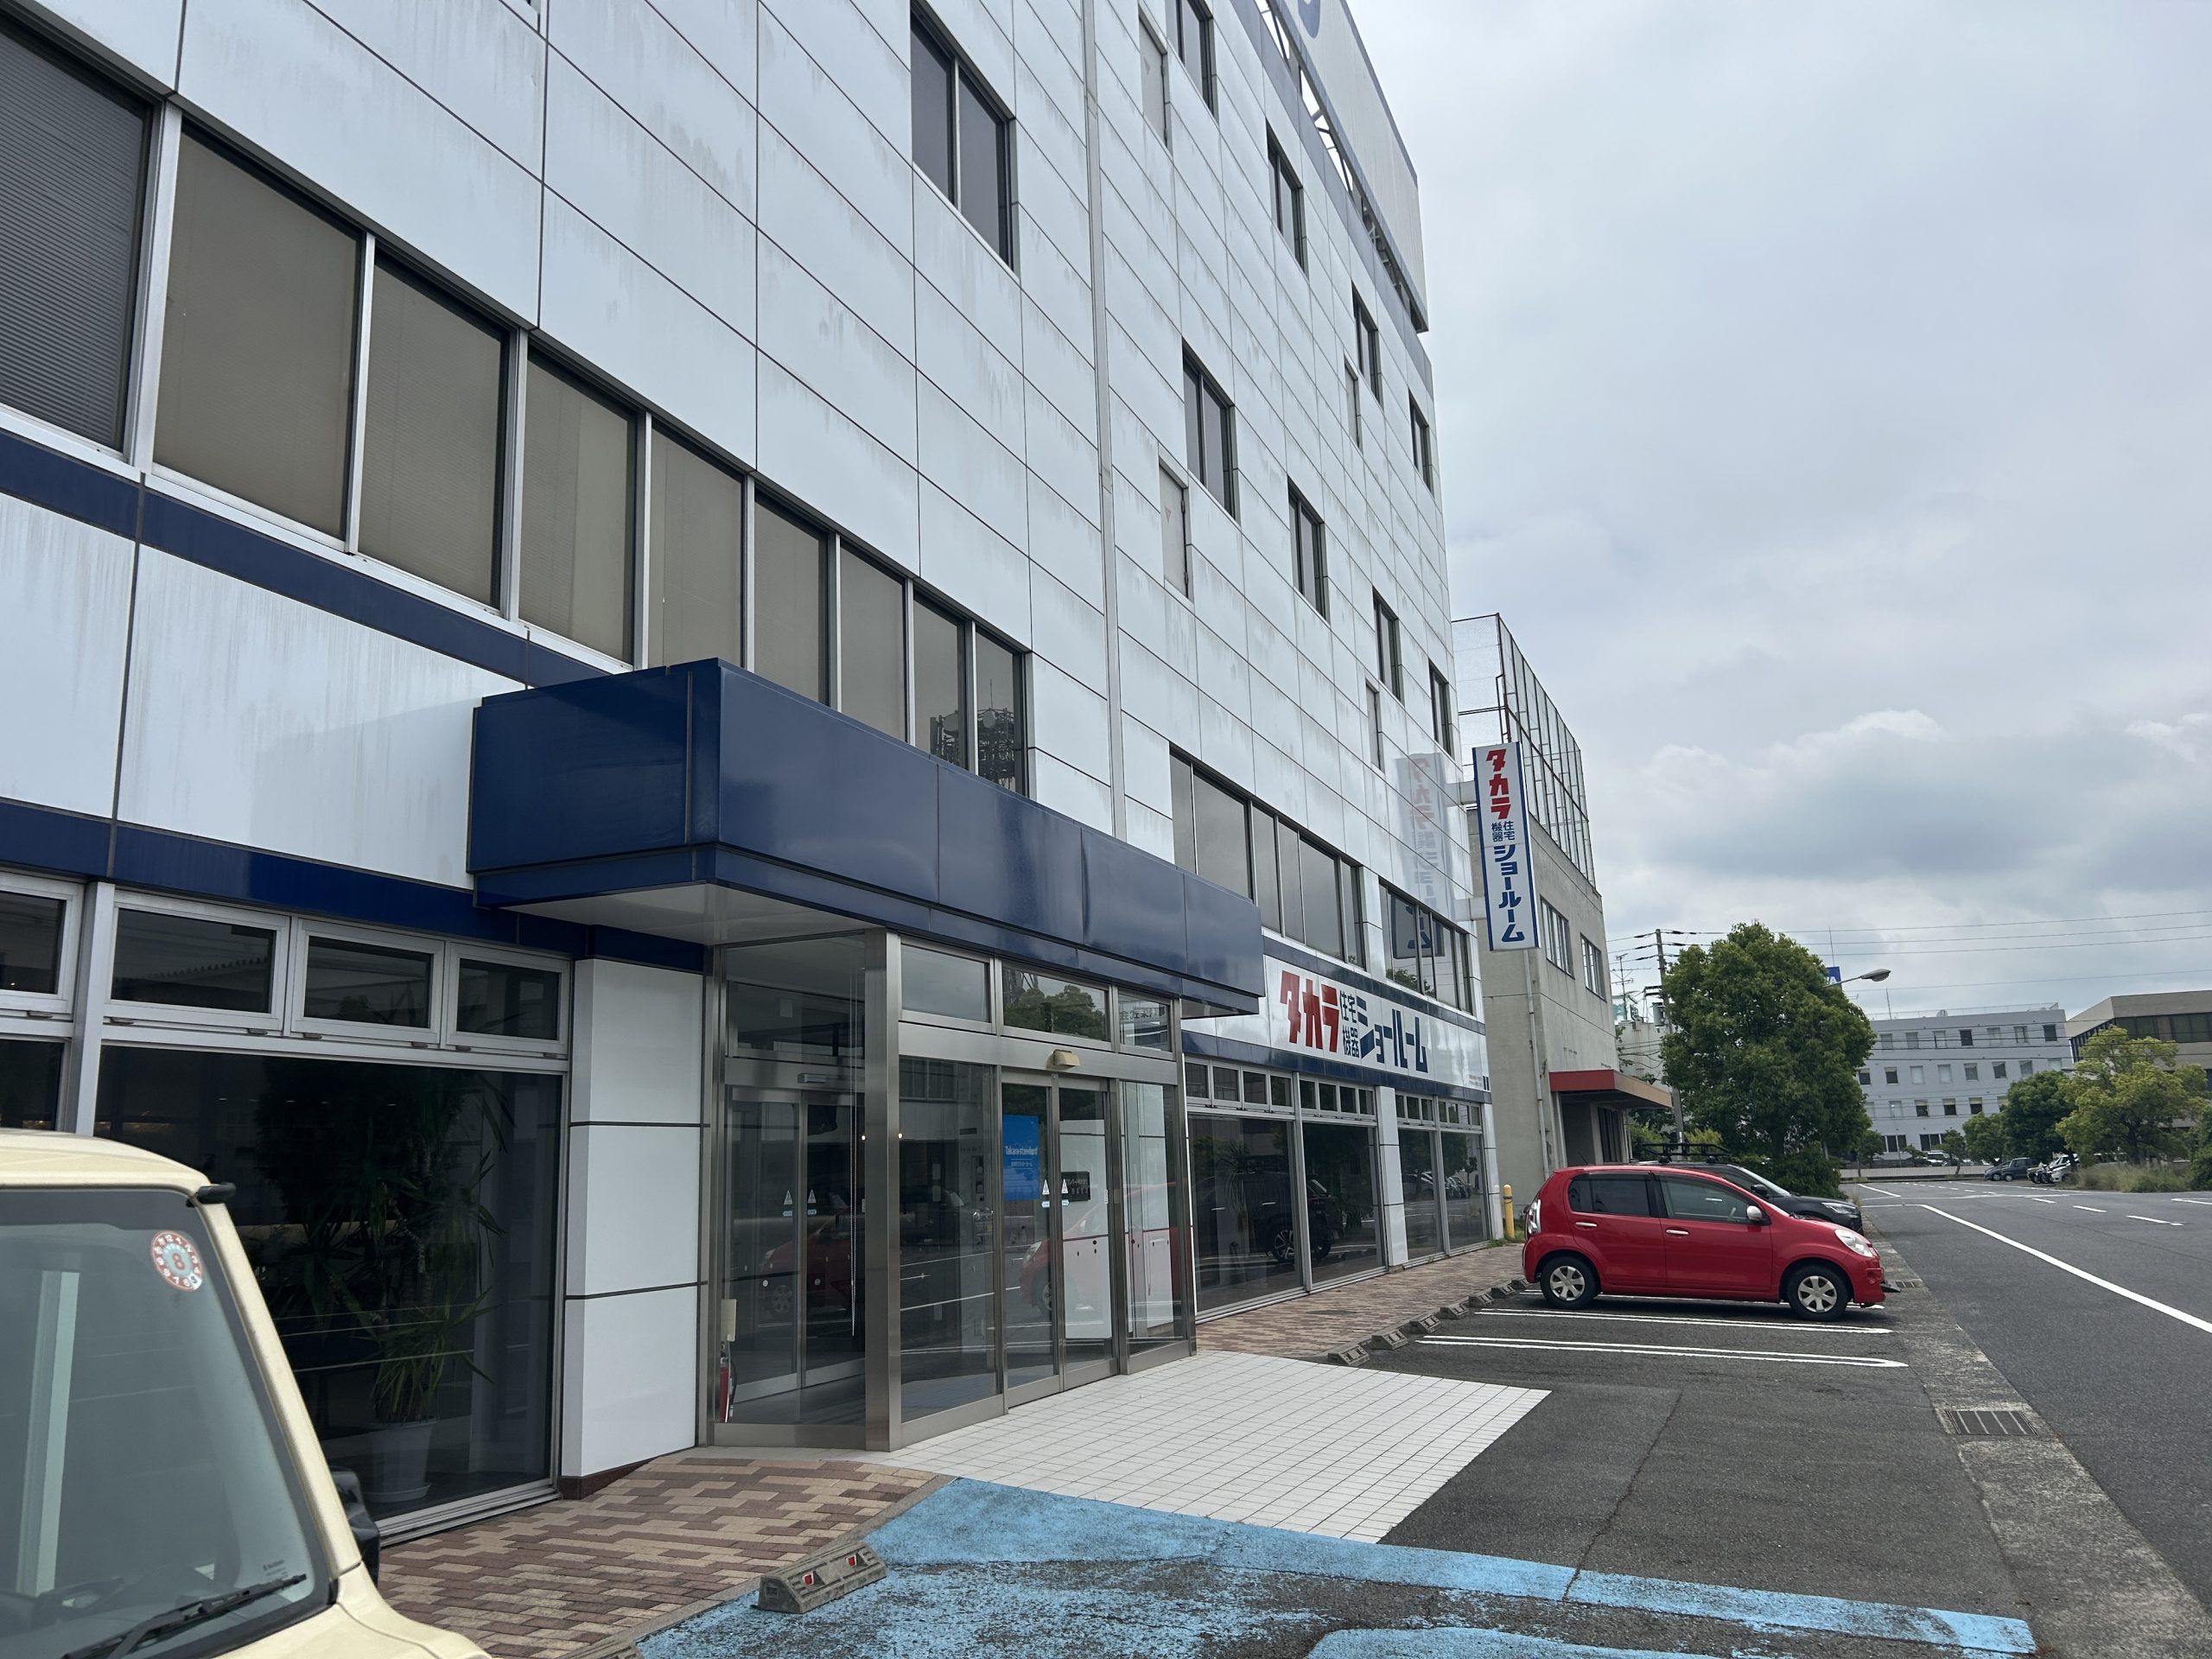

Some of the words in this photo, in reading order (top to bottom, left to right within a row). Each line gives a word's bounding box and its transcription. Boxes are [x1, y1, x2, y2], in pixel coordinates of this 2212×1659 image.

[1486, 749, 1511, 819] タカラ
[1494, 844, 1524, 942] ショールーム
[1281, 970, 1339, 1052] タカラ
[1340, 990, 1357, 1023] 住宅
[1357, 995, 1428, 1073] ショールーム
